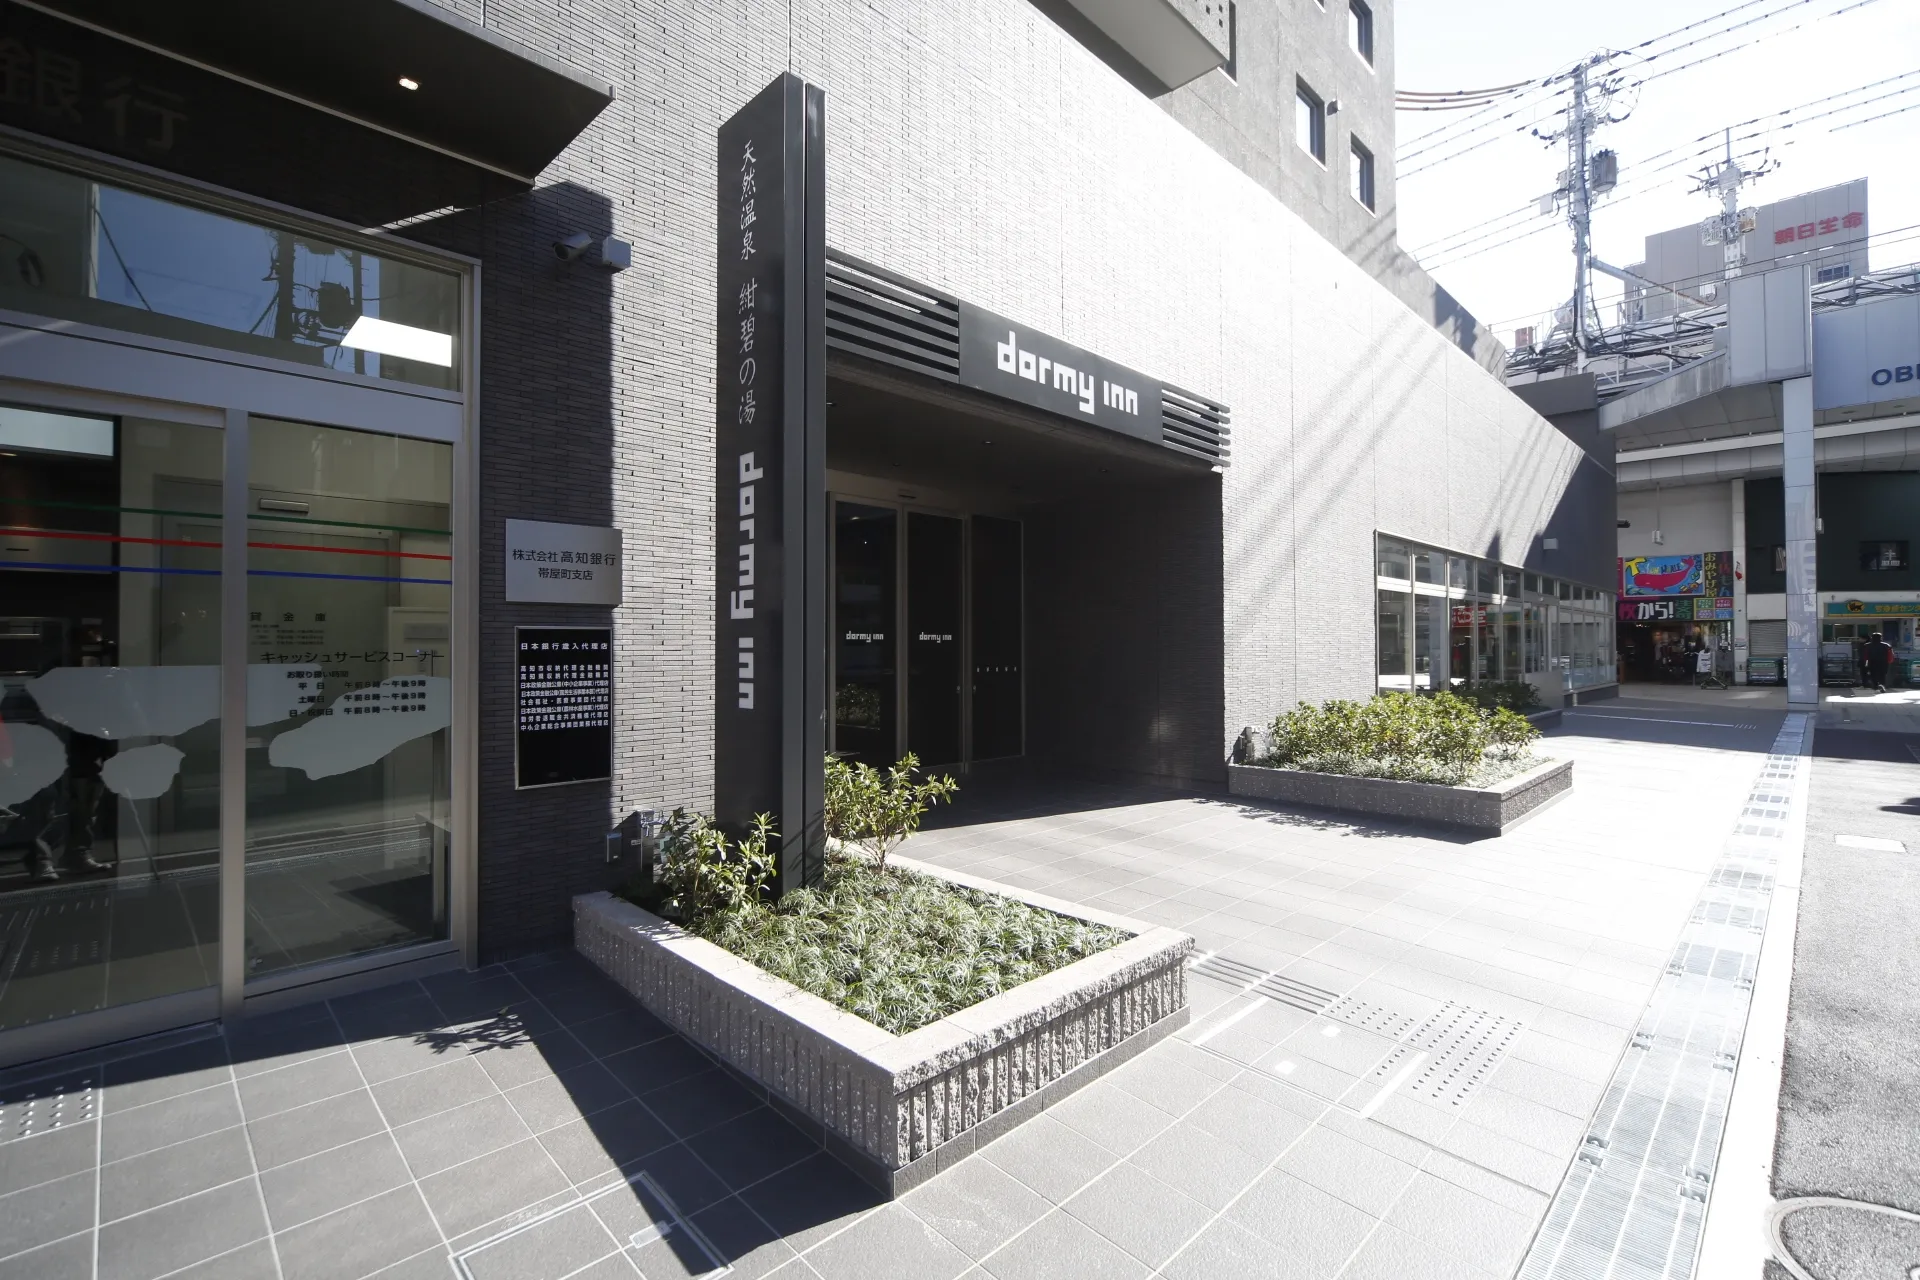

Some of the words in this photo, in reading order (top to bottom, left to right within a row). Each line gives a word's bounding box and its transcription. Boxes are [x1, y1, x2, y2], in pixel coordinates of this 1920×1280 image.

[740, 139, 757, 260] 天然温泉
[1774, 211, 1865, 245] 朝日生命
[738, 277, 758, 425] 紺碧の湯
[997, 330, 1095, 415] dormy
[1103, 380, 1138, 415] inn
[730, 451, 764, 620] dormy
[538, 567, 593, 581] 帯屋町支店
[845, 630, 872, 643] dormy
[919, 632, 941, 643] dormy
[521, 642, 608, 650] 日本銀行歳入代理店
[260, 651, 445, 664] キャッシュサービスコーナー
[287, 670, 348, 679] お取り扱い時間
[738, 637, 755, 710] inn
[298, 682, 325, 690] 平日
[298, 695, 325, 704] 土曜日
